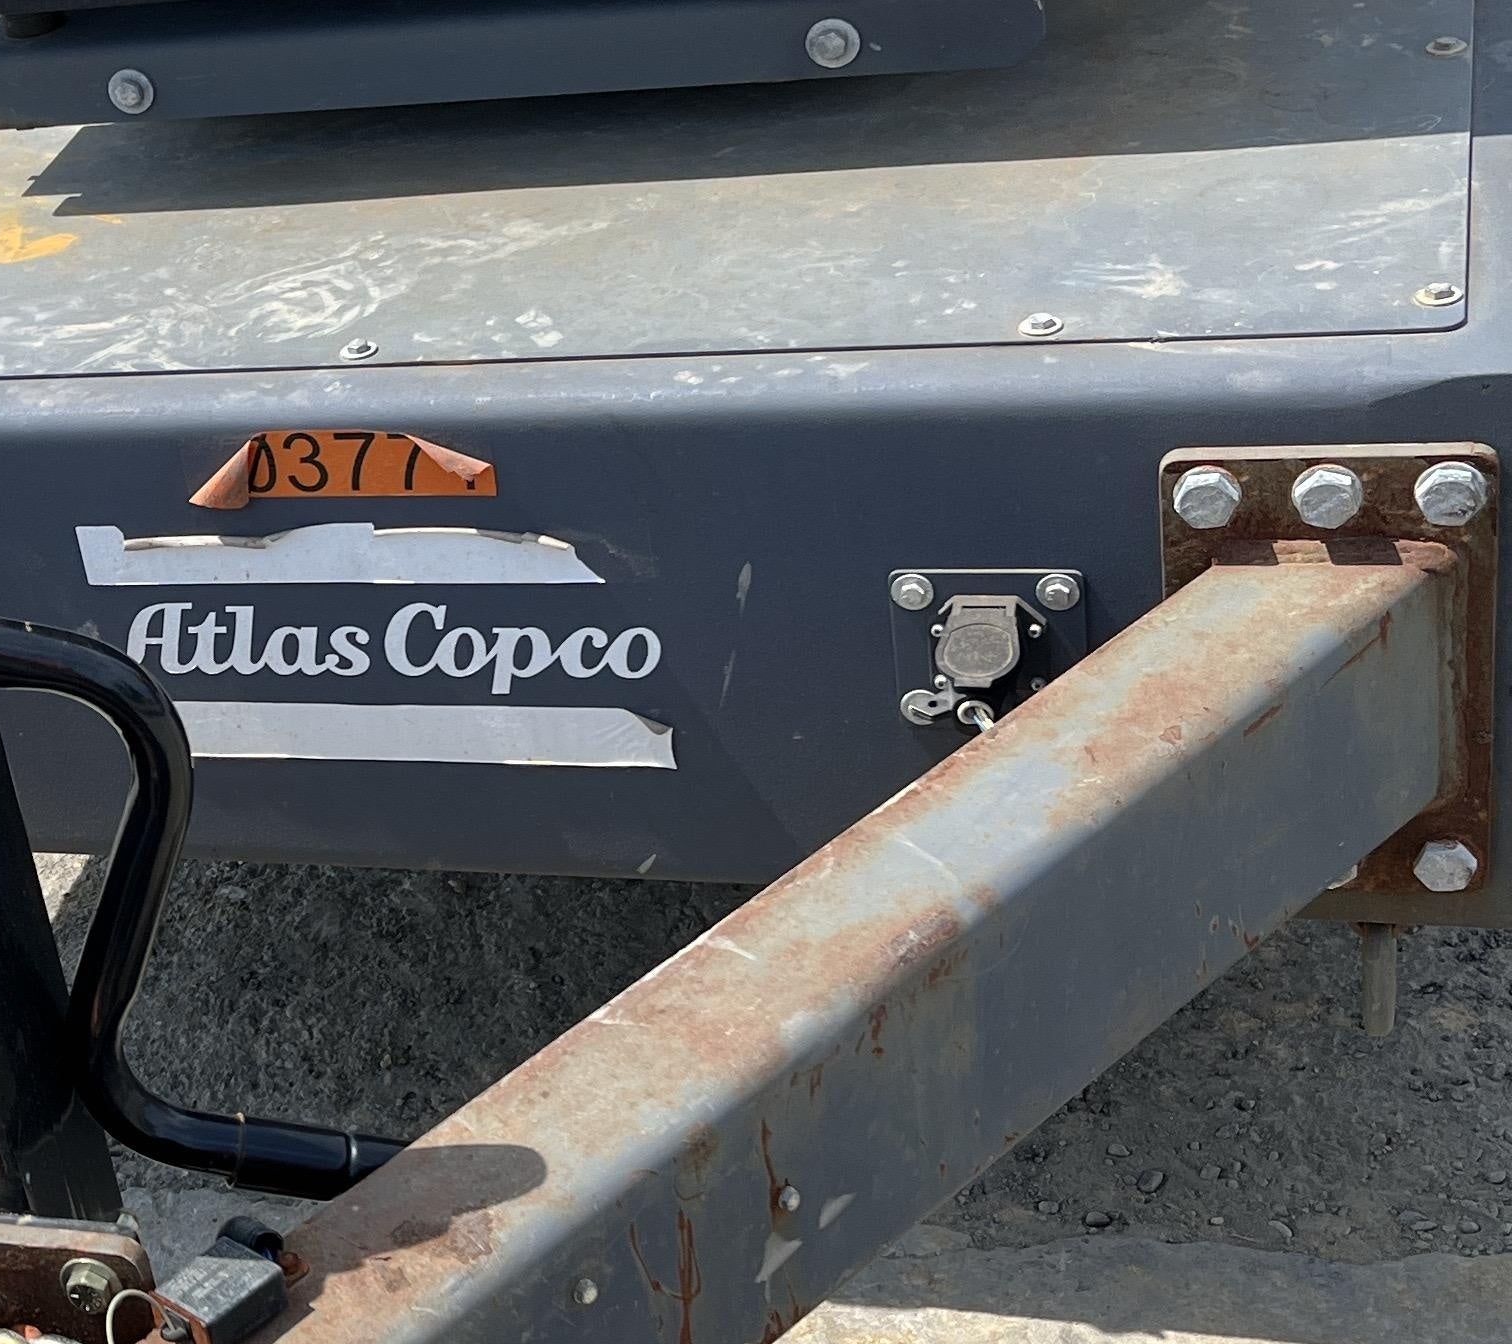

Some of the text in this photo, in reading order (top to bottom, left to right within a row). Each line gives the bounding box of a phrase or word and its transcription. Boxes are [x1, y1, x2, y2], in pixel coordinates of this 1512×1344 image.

[248, 432, 476, 495] 0377
[126, 601, 662, 695] Atlas Copco
